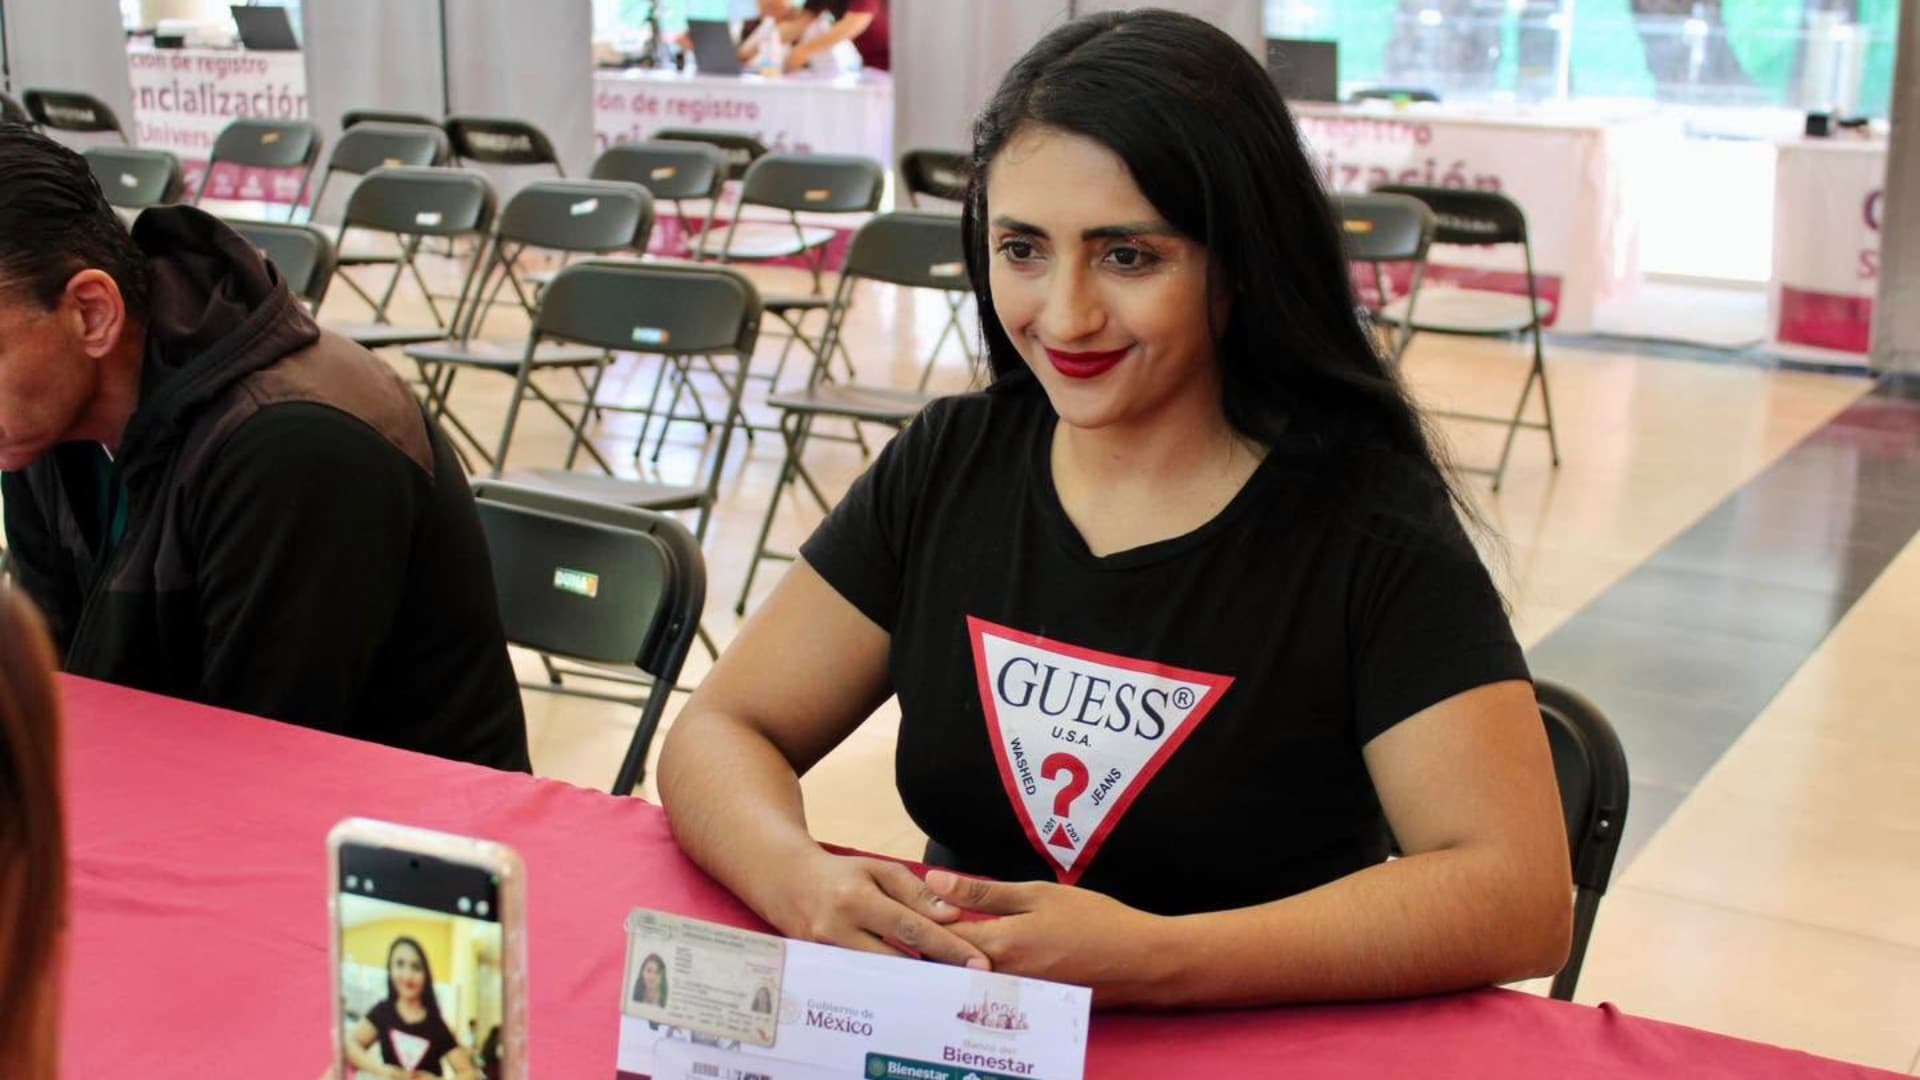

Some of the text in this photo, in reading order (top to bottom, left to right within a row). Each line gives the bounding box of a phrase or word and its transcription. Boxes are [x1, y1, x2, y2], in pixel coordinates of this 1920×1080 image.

[198, 57, 268, 79] registro
[665, 92, 760, 123] registro
[1051, 726, 1092, 748] U.S.A.
[1010, 737, 1037, 797] WASHED
[1090, 767, 1121, 807] JEANS
[805, 1009, 874, 1037] México
[887, 1060, 950, 1080] Bienestar
[942, 1046, 1035, 1076] Bienestar
